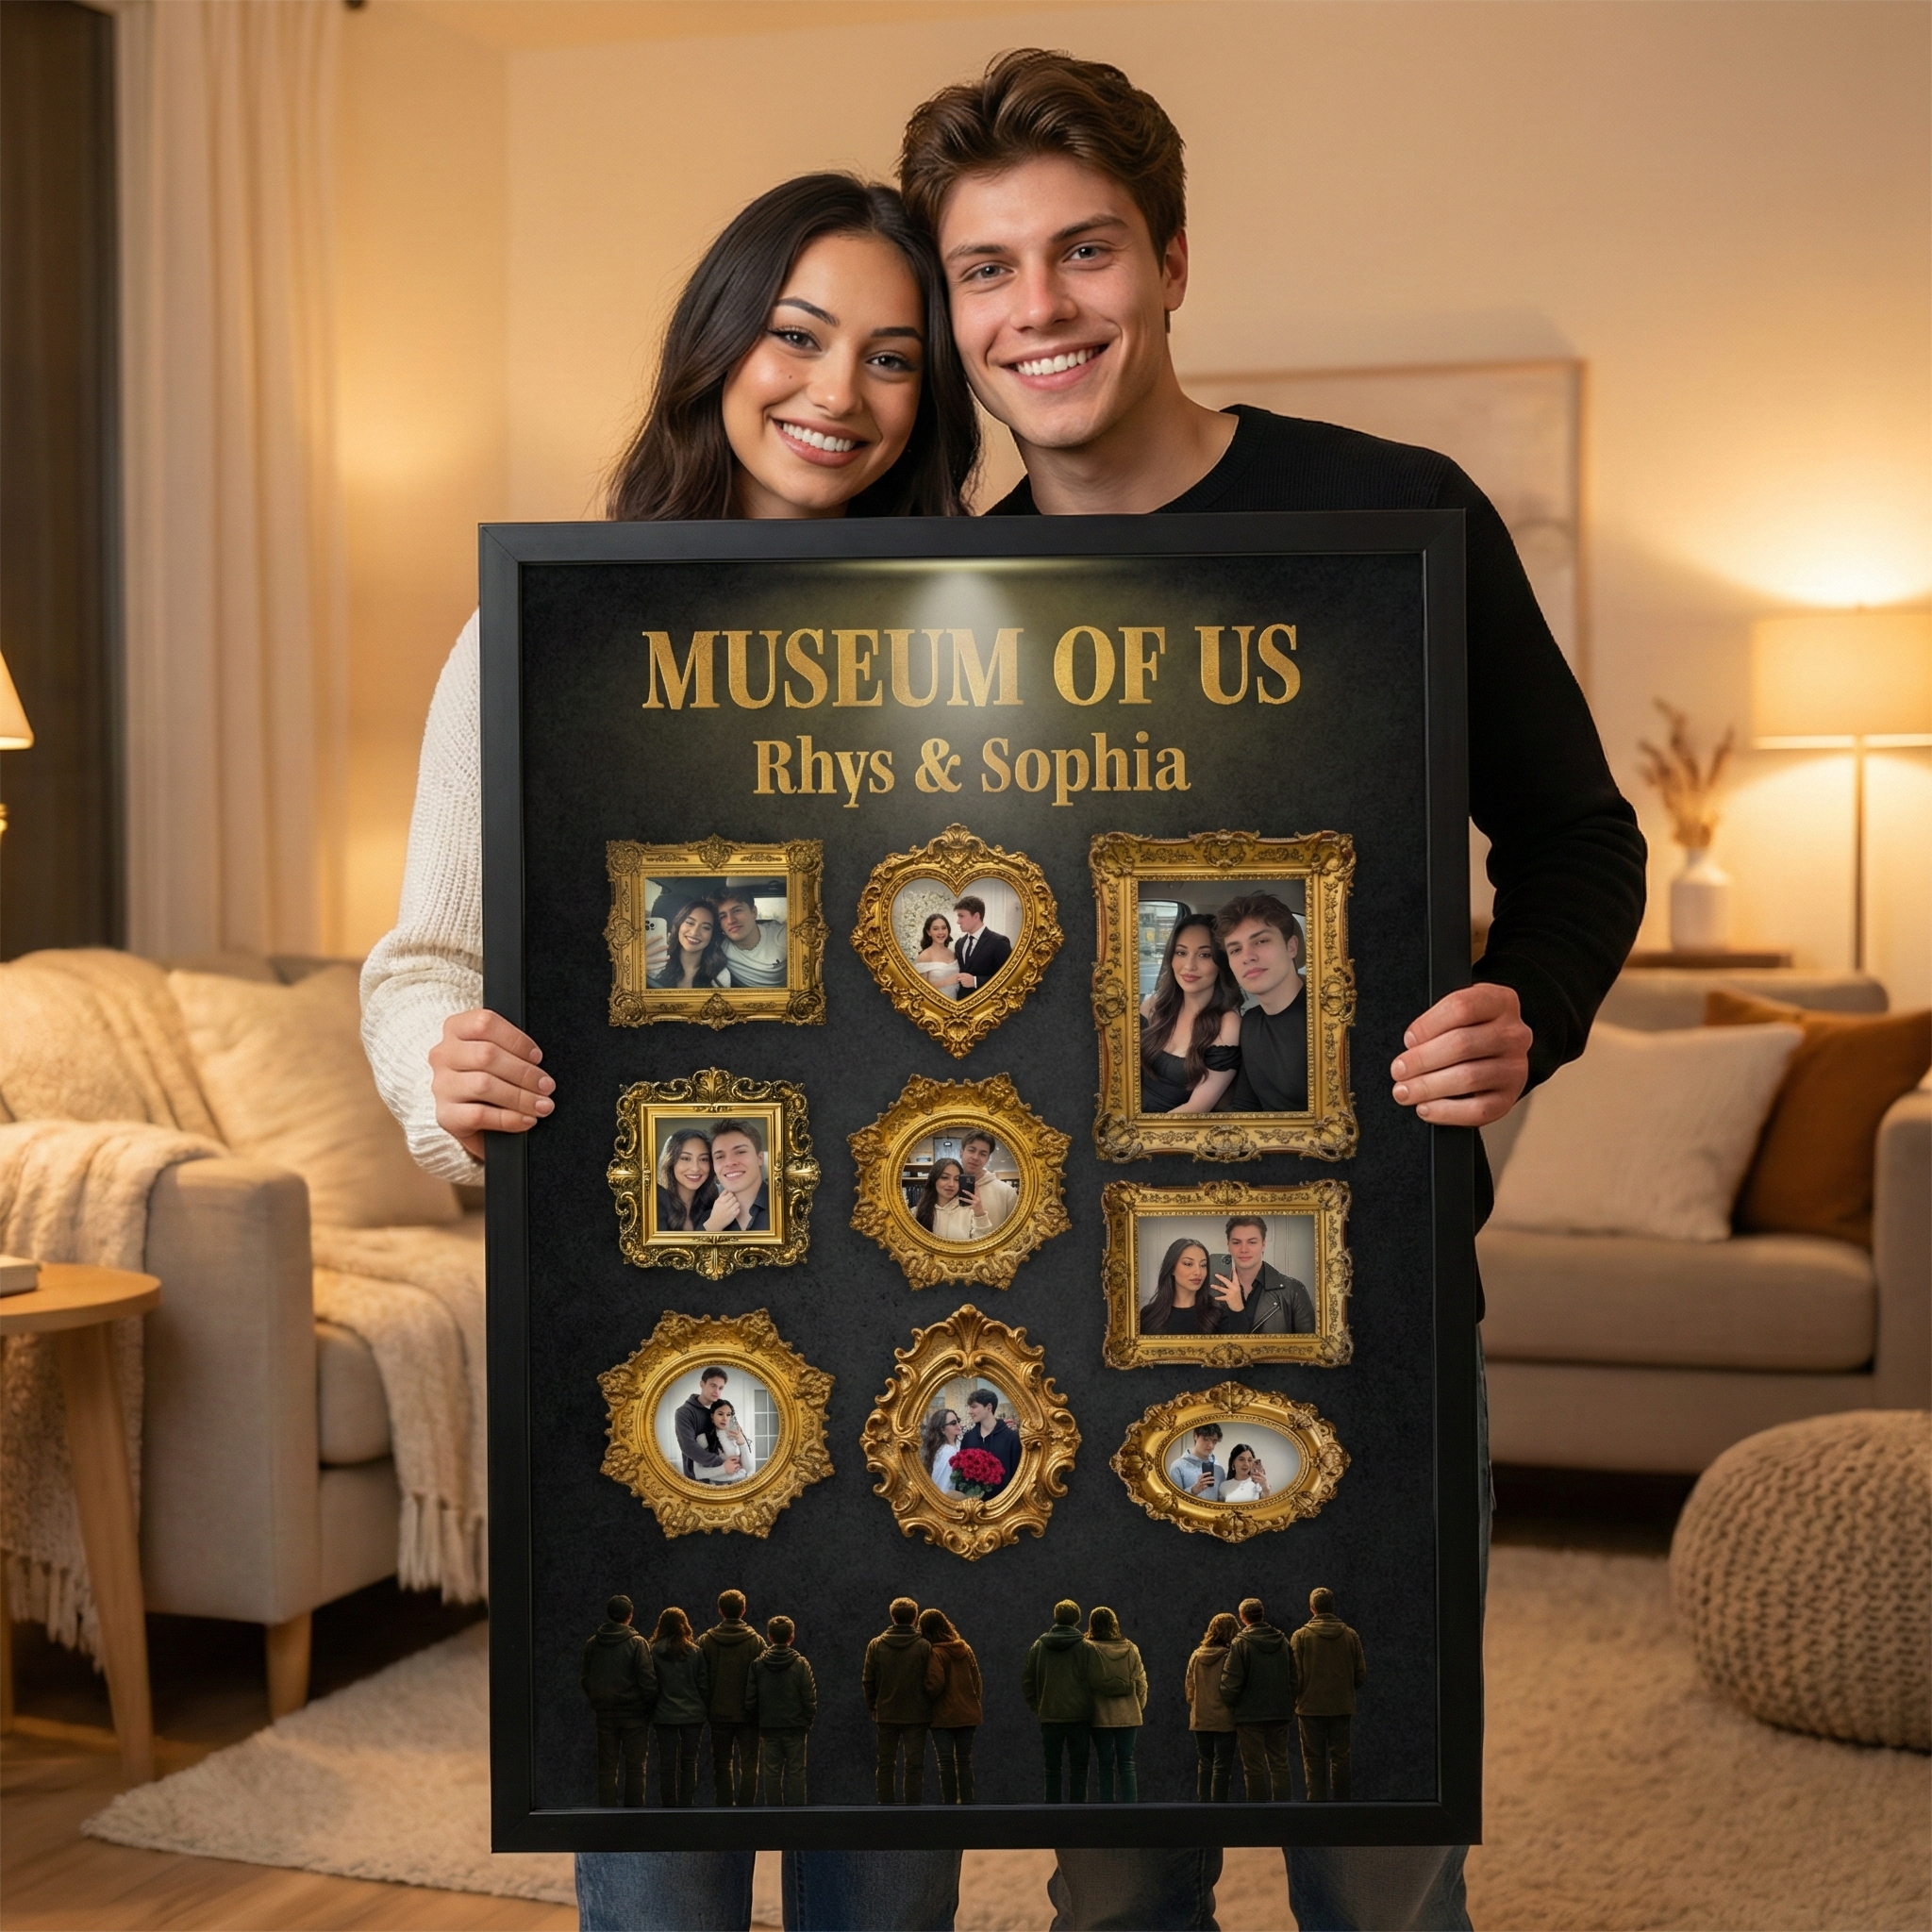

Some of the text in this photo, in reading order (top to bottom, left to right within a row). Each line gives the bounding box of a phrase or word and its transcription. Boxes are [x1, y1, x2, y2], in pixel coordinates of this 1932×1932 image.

[642, 623, 1301, 709] MUSEUM OF US
[753, 731, 1191, 808] Rhys & Sophia
